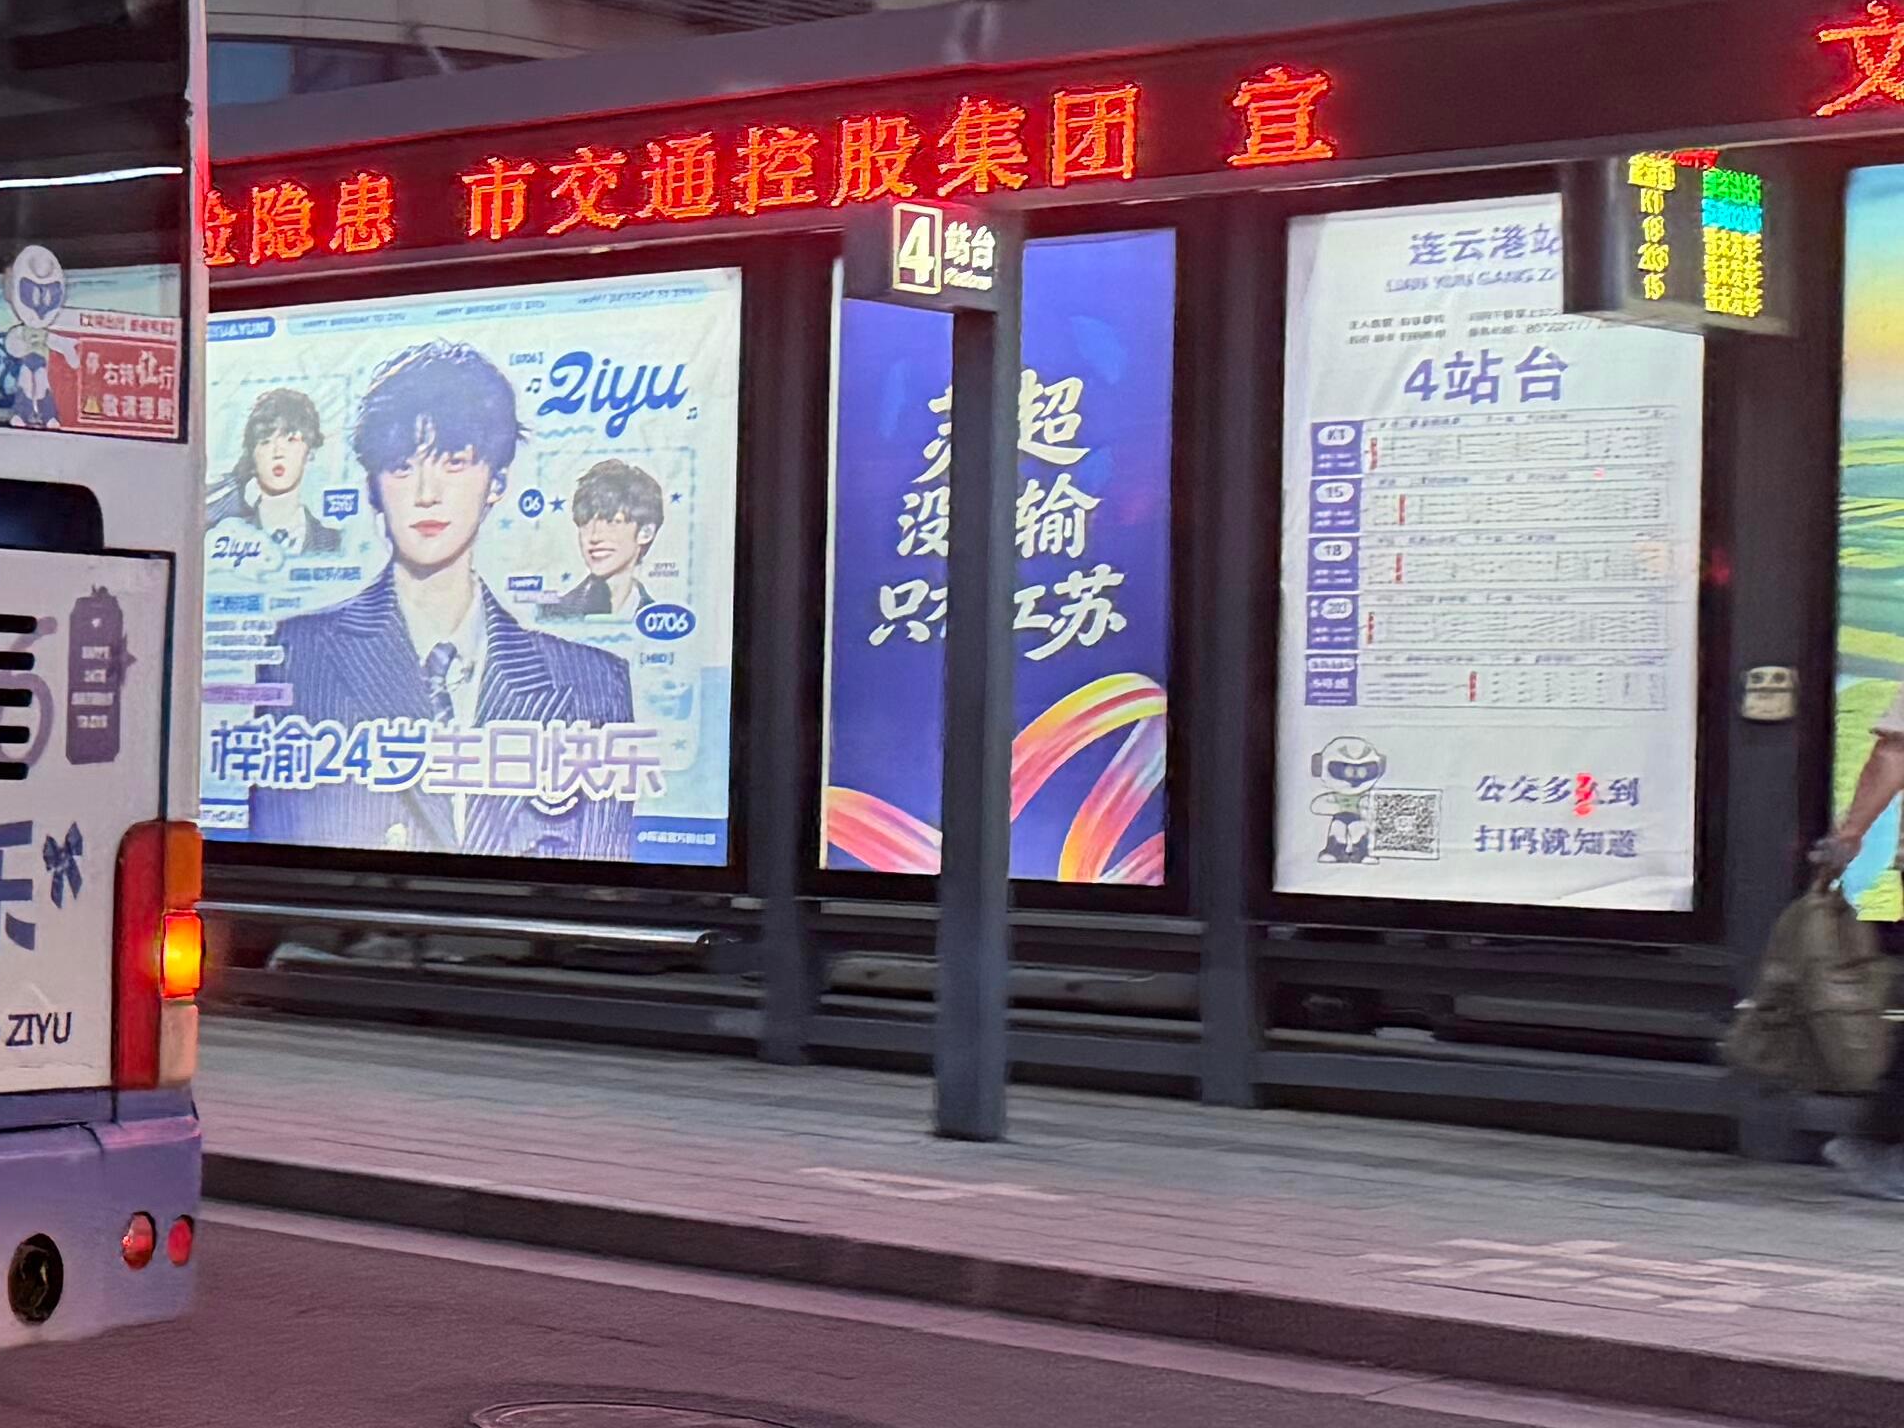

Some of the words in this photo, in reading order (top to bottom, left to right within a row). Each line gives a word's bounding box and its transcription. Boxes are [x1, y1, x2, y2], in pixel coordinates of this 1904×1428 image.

[463, 82, 1138, 240] 市交通控股集团
[898, 216, 935, 284] 4
[1408, 222, 1563, 266] 连云港站
[537, 351, 689, 438] Ziyu
[1404, 345, 1569, 404] 4站台
[522, 495, 540, 511] 06
[211, 536, 261, 567] Ziyu
[645, 614, 688, 632] 0706
[869, 563, 1128, 661] 只江苏
[1474, 824, 1638, 858] 扫码就知道
[5, 1009, 73, 1047] ZIYU
